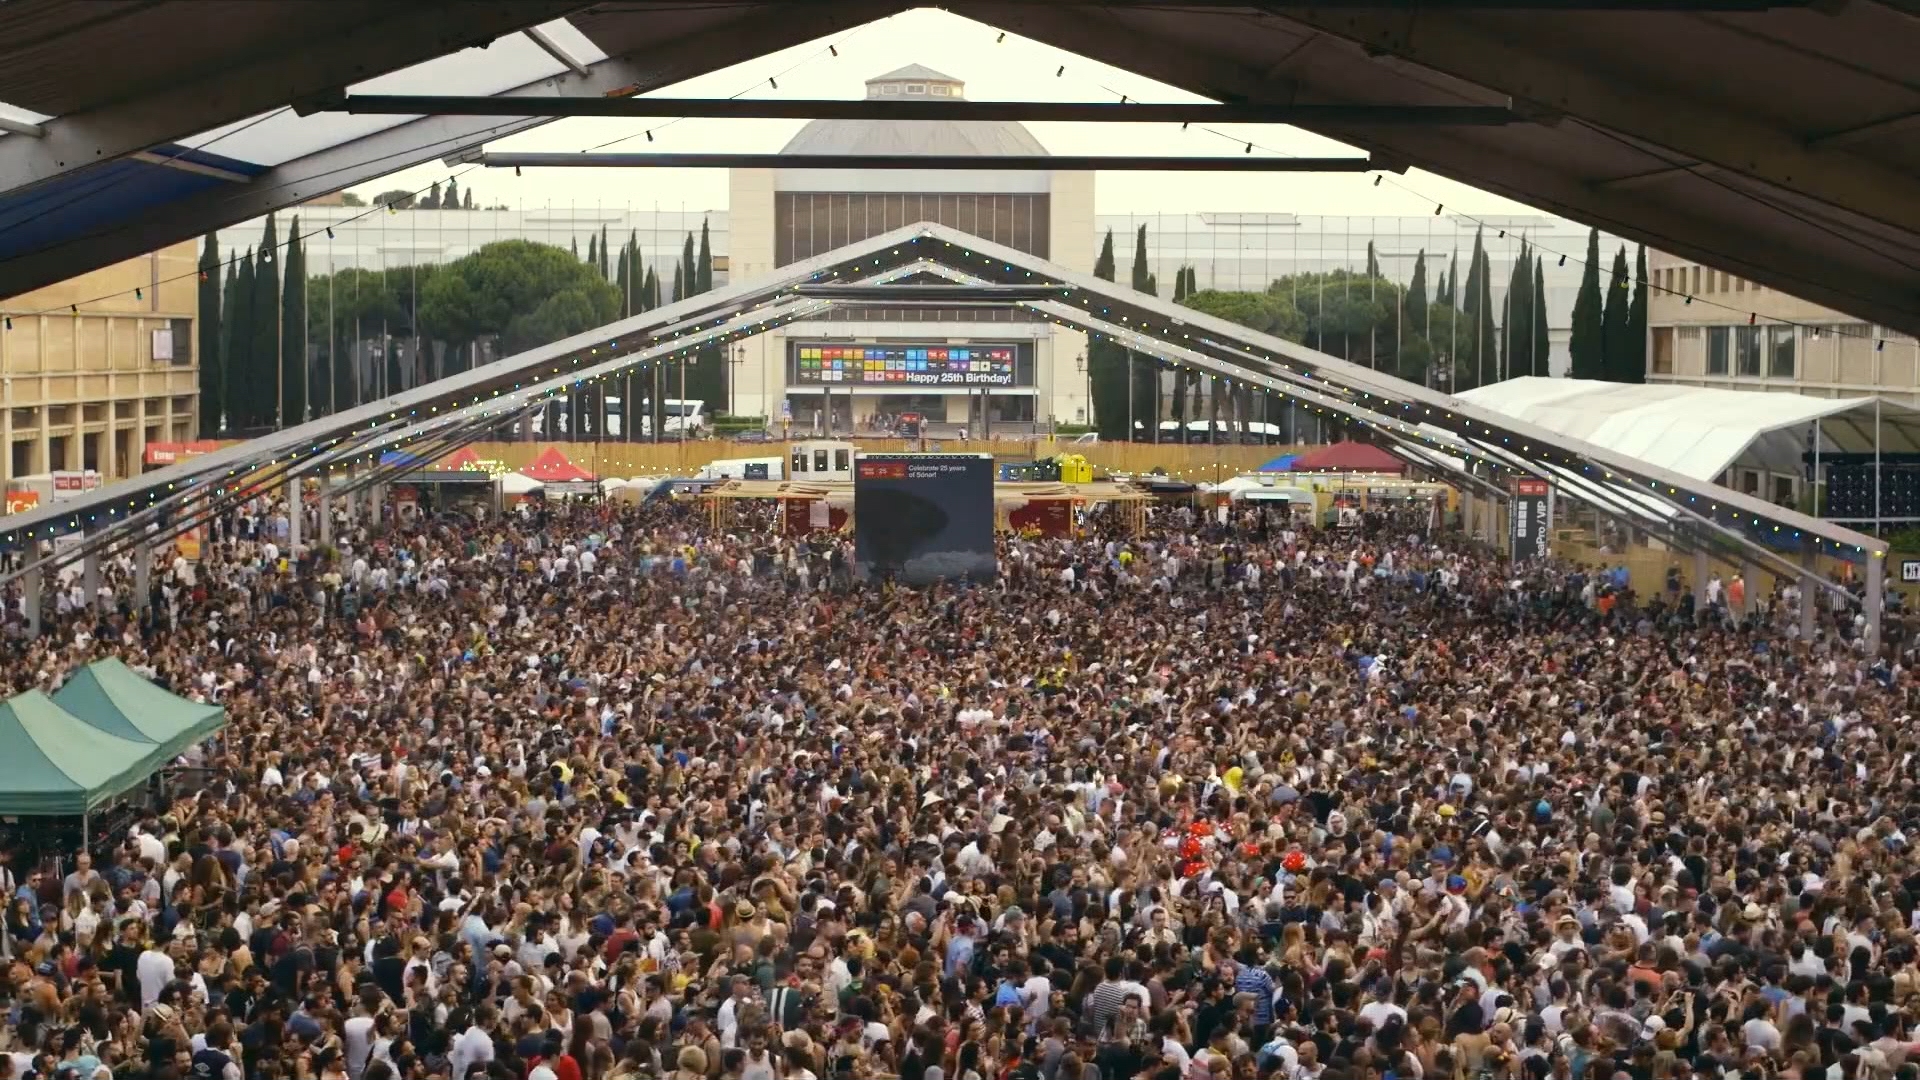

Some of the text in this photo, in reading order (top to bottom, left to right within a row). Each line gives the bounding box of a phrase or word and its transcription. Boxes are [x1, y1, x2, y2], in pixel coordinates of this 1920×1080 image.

[906, 372, 939, 383] Happy
[941, 373, 963, 382] 25th
[966, 373, 1011, 384] Birthday!
[1536, 501, 1546, 518] VIP
